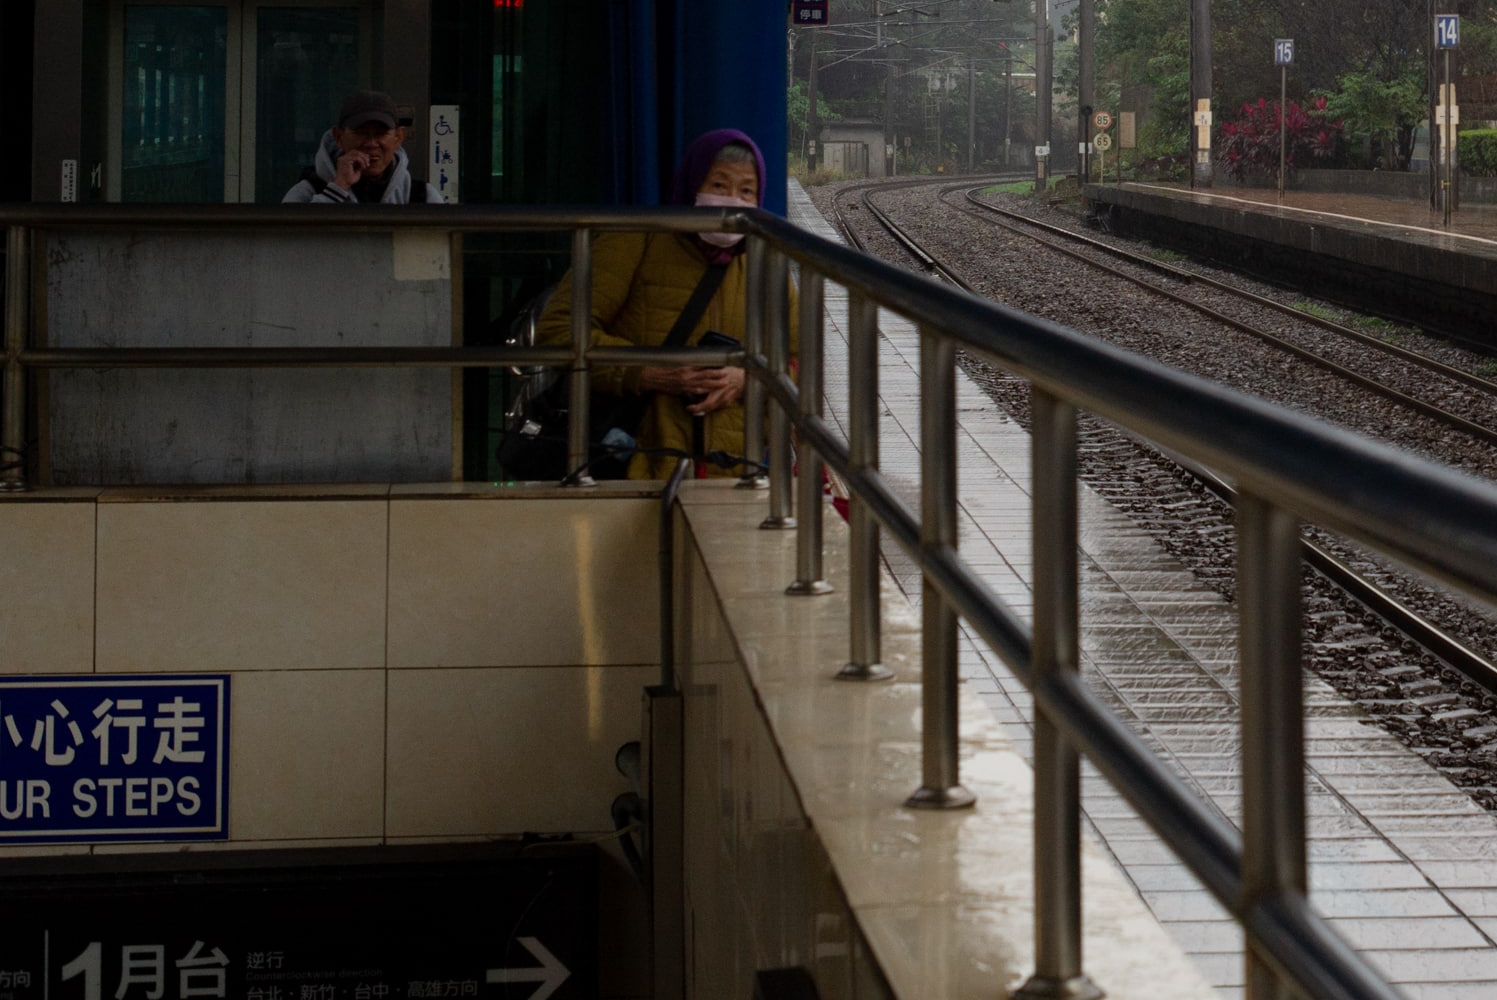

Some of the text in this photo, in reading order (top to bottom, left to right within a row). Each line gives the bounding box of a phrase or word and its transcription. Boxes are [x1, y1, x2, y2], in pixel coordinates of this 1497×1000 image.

[1438, 18, 1457, 45] 14
[1278, 43, 1292, 62] 15
[1097, 116, 1108, 125] 85
[1097, 137, 1108, 146] 65
[0, 775, 201, 820] UR STEPS
[246, 951, 285, 969] 逆行
[338, 967, 383, 978] direction
